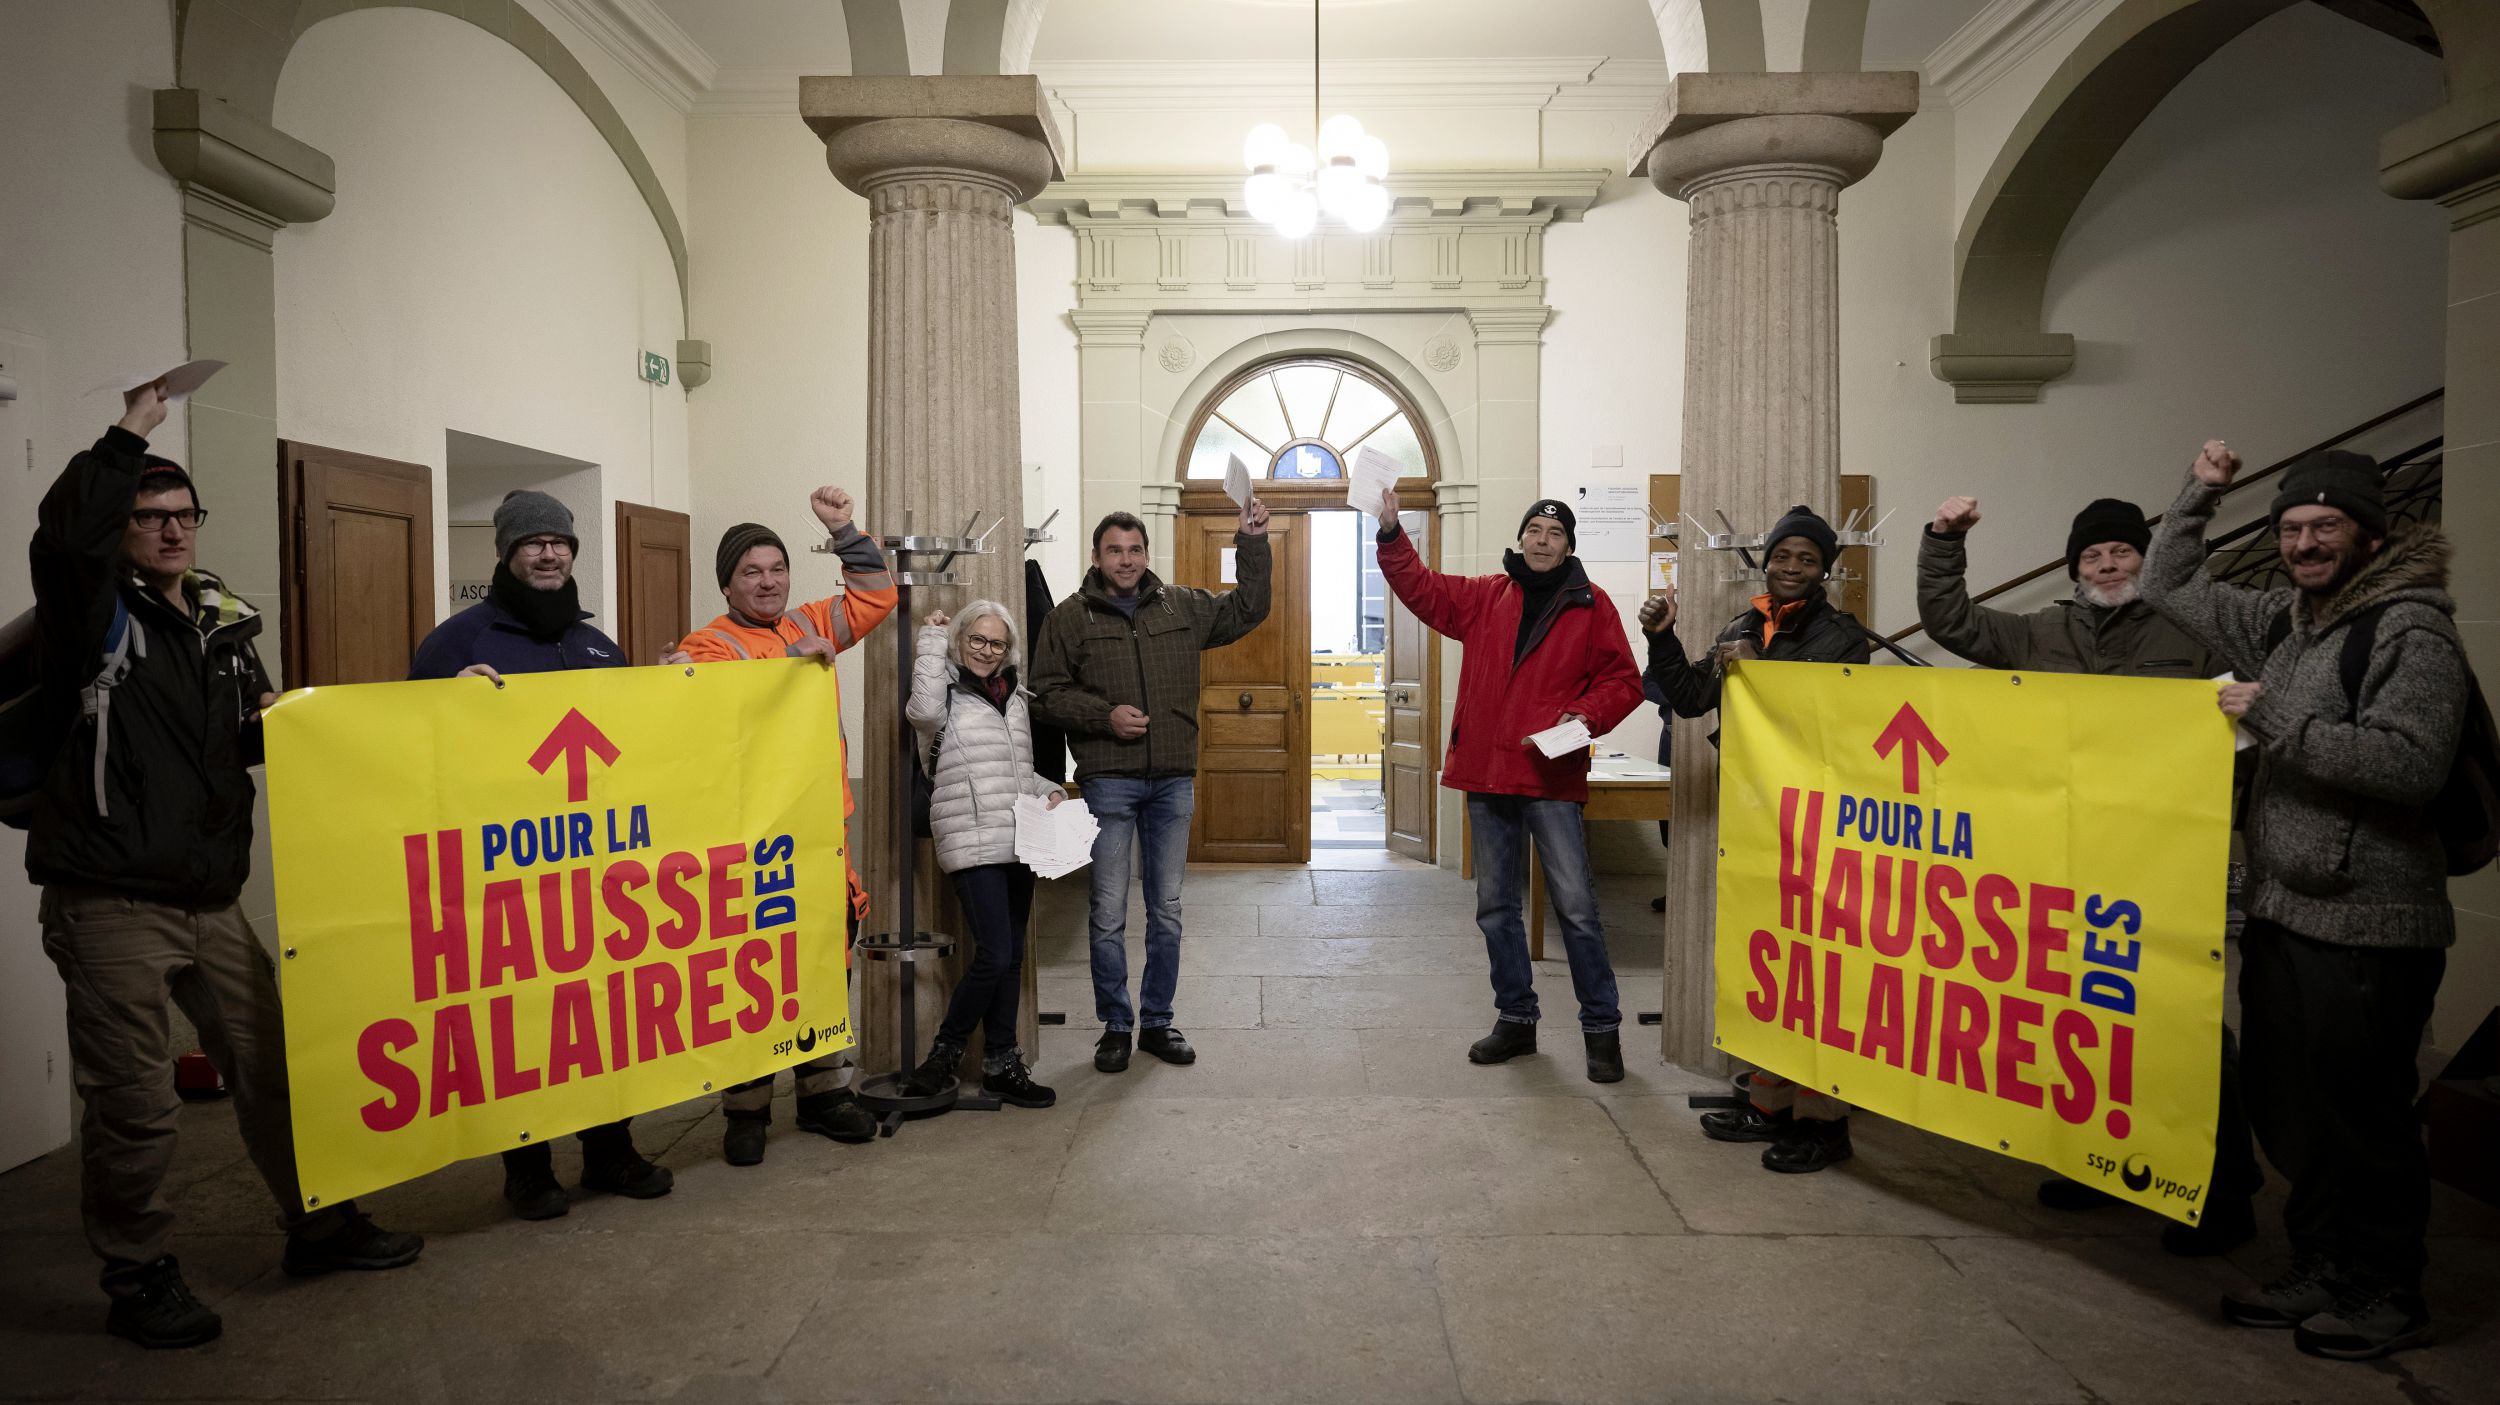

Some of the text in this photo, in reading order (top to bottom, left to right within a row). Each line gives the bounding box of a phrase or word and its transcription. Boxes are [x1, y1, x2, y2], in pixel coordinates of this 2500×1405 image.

[482, 804, 651, 872] POUR LA
[1836, 794, 1974, 860] POUR LA
[403, 828, 749, 1003] HAUSSE
[754, 834, 797, 931] DES
[1779, 786, 2076, 999] HAUSSE
[2080, 893, 2143, 1017] DES
[356, 931, 800, 1133] SALAIRES!
[772, 1017, 847, 1056] ssp vpod
[1745, 929, 2136, 1141] SALAIRES!
[2086, 1152, 2203, 1203] ssp vpod
